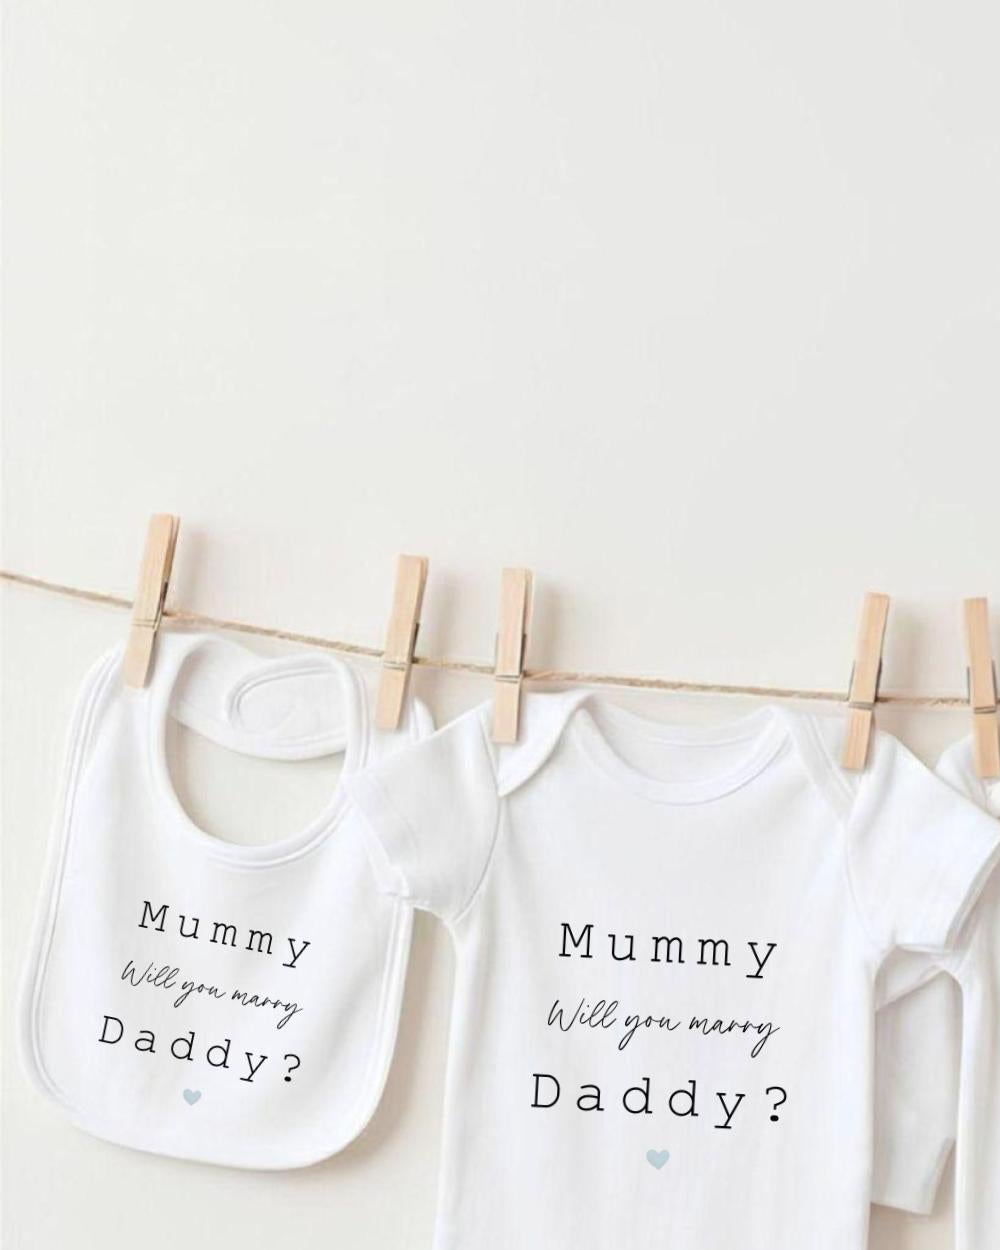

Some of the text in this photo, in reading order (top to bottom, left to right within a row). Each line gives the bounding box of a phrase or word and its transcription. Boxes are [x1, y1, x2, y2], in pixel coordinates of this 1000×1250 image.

[139, 901, 310, 968] Mummy
[558, 923, 778, 978] Mummy
[121, 960, 304, 1029] Will you marry
[99, 1016, 301, 1082] Daddy?
[547, 999, 780, 1058] Will you marry
[531, 1074, 787, 1129] Daddy?
